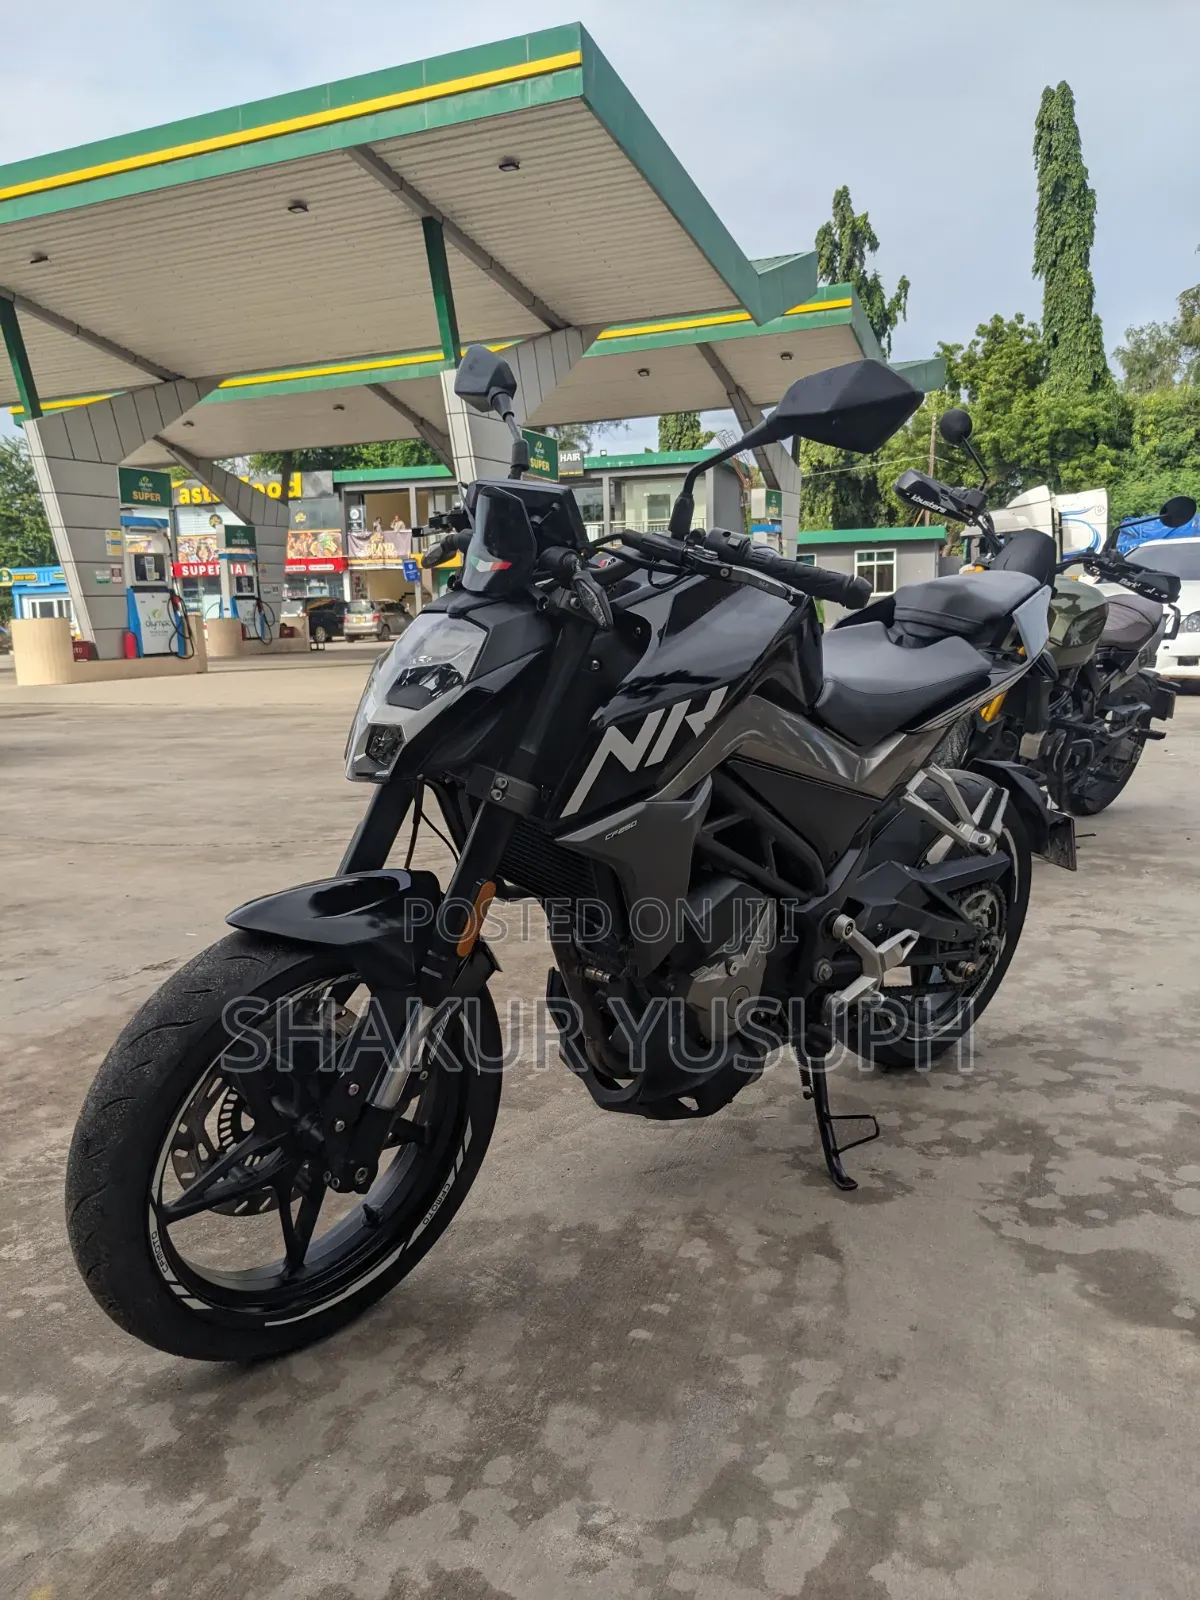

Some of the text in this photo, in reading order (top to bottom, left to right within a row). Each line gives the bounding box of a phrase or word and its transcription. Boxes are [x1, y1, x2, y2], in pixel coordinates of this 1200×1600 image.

[530, 457, 550, 472] SUPER
[560, 452, 581, 462] HAIR
[132, 490, 161, 502] SUPER
[422, 1183, 451, 1225] CFMOTO
[151, 1230, 169, 1273] CFMOTO
